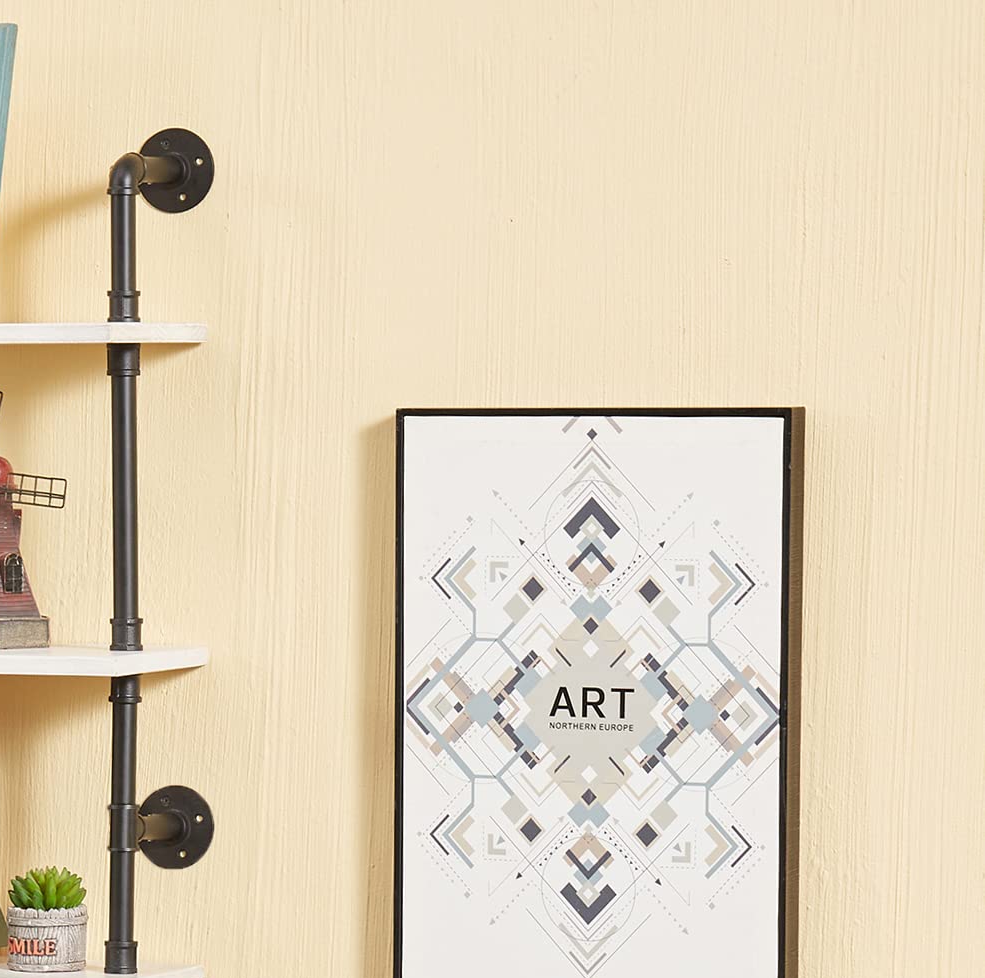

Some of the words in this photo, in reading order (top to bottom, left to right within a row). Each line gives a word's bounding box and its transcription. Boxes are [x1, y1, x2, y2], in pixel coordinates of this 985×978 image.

[549, 686, 634, 719] ART
[549, 722, 596, 731] NORTHERN
[599, 723, 634, 732] EUROPE
